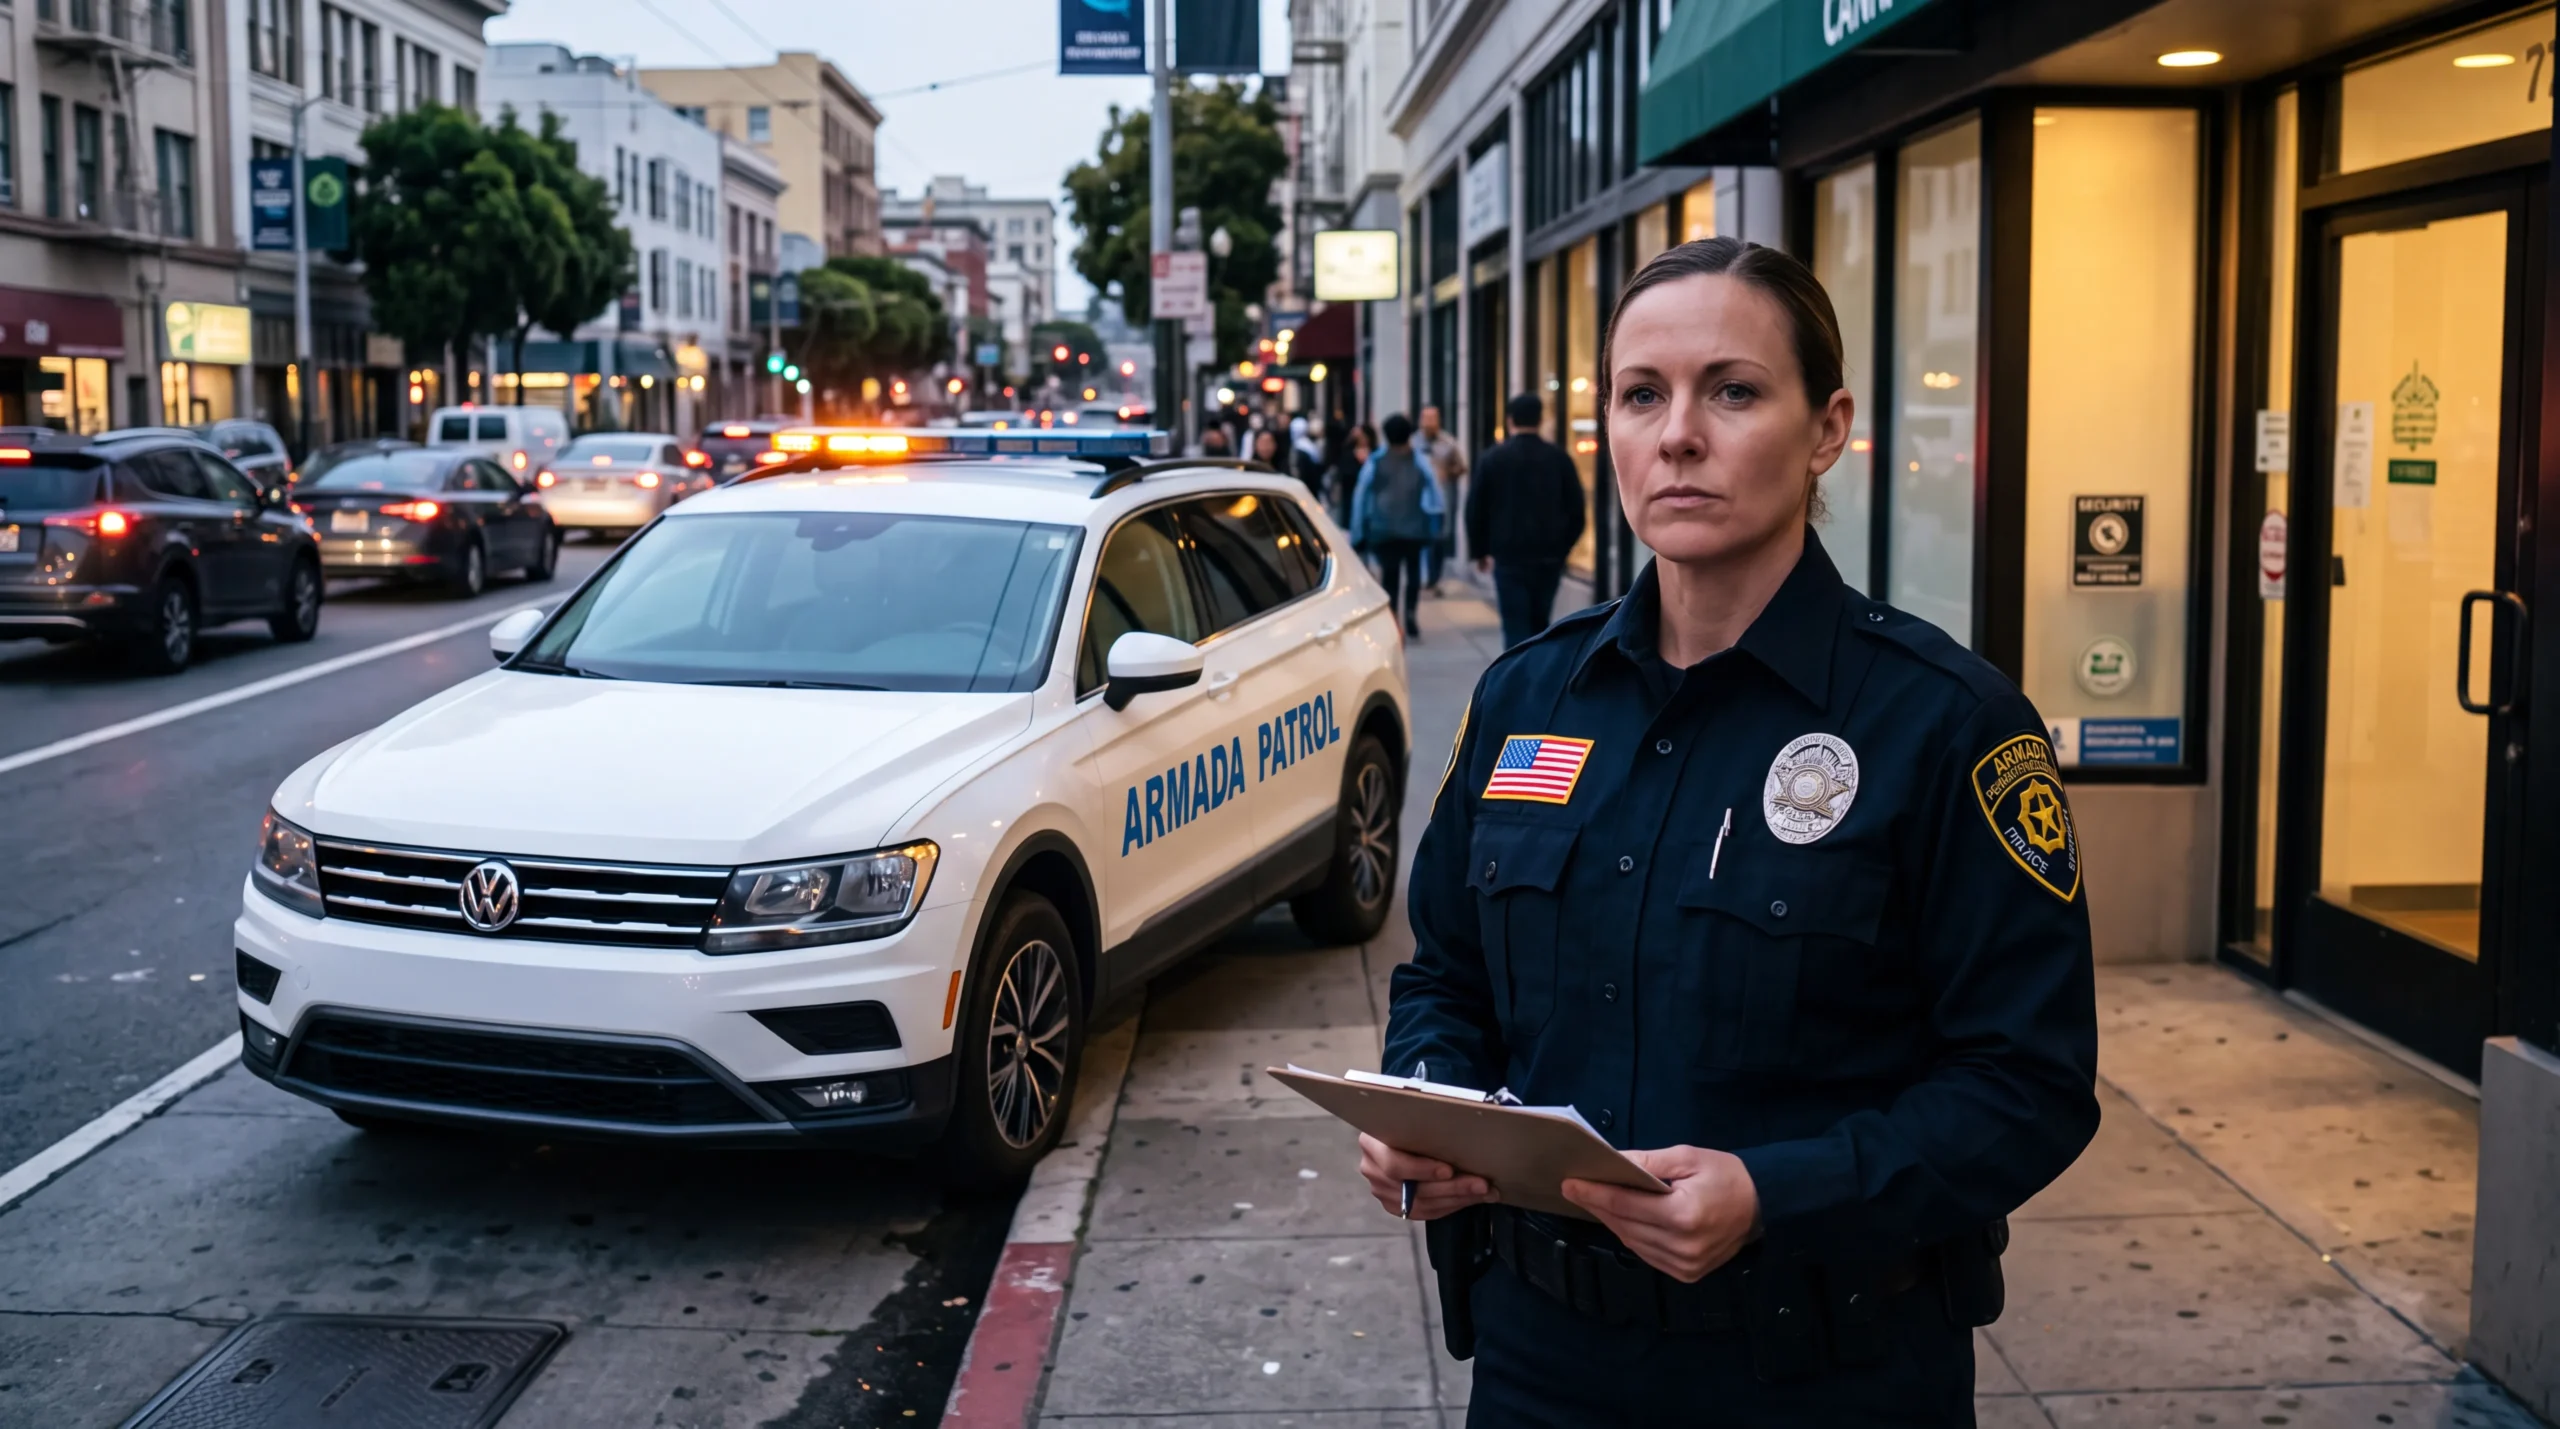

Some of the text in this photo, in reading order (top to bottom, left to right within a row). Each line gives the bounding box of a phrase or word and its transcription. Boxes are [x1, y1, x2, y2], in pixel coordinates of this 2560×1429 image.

[1823, 0, 1893, 47] CAN
[2526, 40, 2554, 104] 7
[1122, 690, 1340, 857] ARMADA PATROL
[1993, 741, 2047, 776] ARMADA
